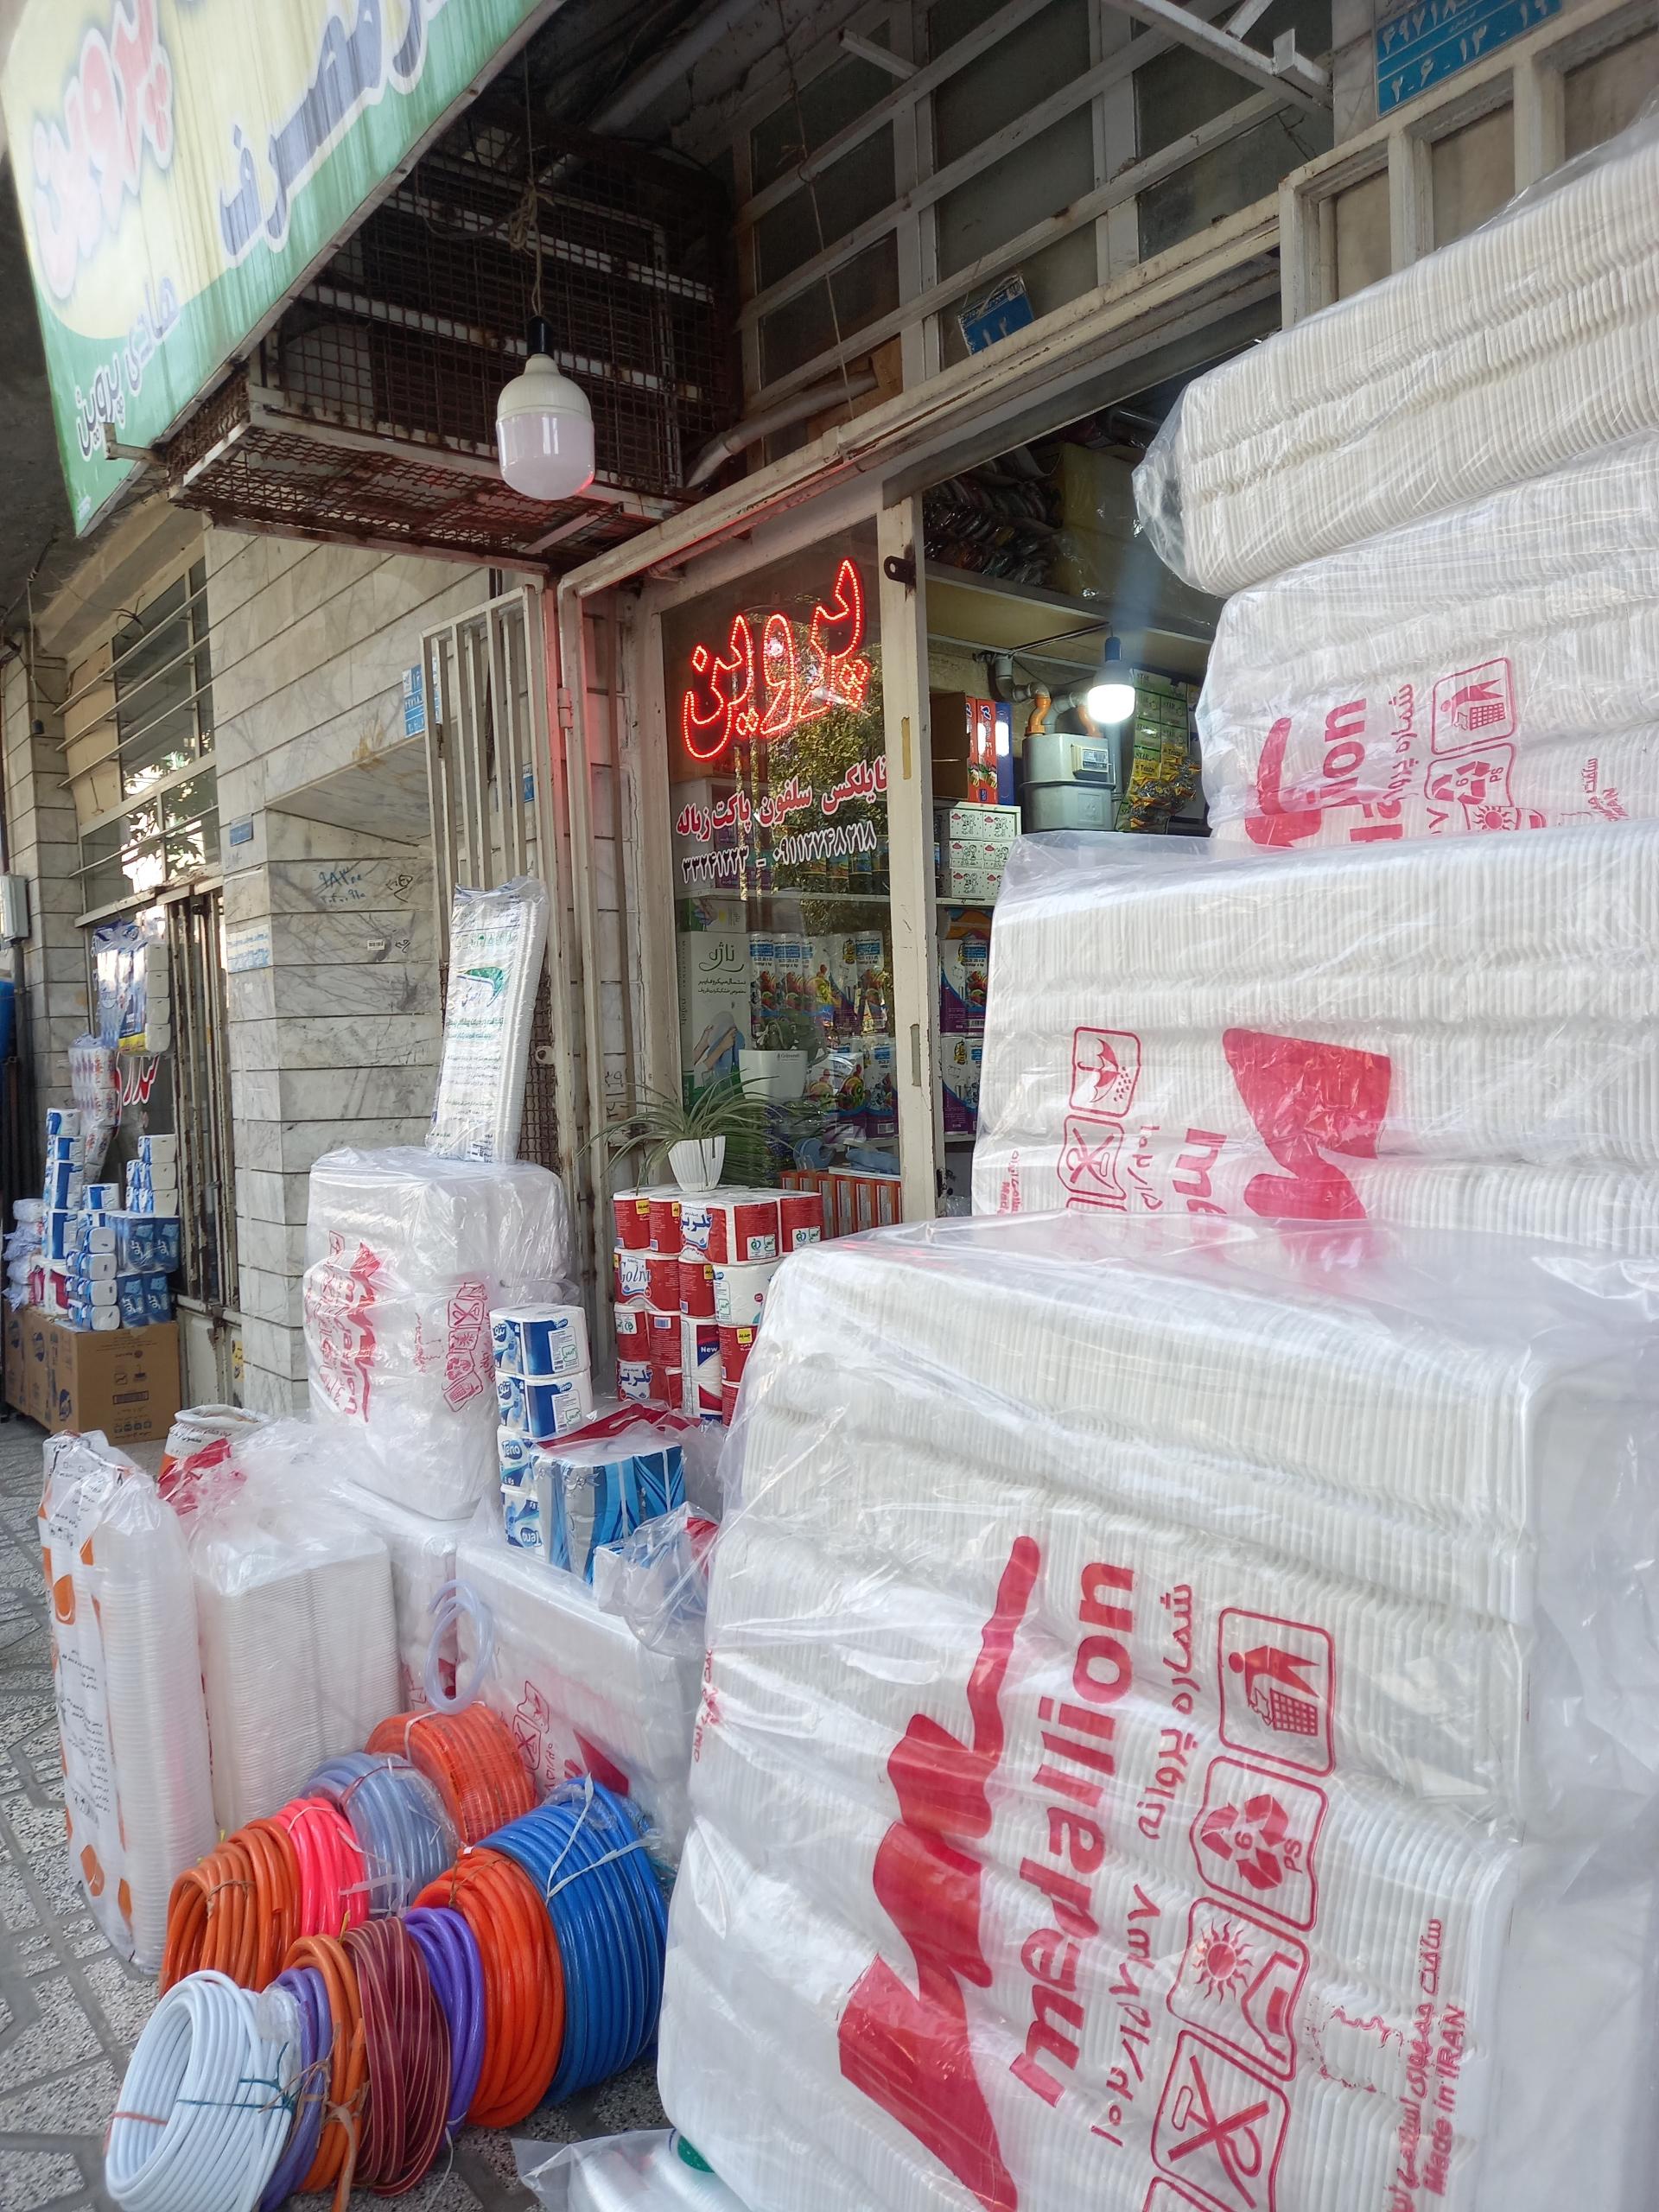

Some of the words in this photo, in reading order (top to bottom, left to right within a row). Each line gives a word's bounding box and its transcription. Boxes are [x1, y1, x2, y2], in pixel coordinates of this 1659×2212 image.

[682, 557, 871, 760] پروین
[677, 804, 713, 842] زباله
[712, 790, 752, 834] پاکت
[759, 776, 813, 827] سلفون
[501, 1440, 522, 1458] Teno
[521, 1529, 543, 1548] Teno
[1160, 1584, 1202, 1716] شماره
[1138, 1728, 1200, 1840] پروانه
[1008, 1562, 1136, 2108] medallion
[1284, 1840, 1304, 1874] PS
[1418, 1918, 1443, 1996] ساخت
[1406, 2002, 1434, 2100] جمهوری
[1436, 2003, 1466, 2080] IRAN
[1433, 2085, 1457, 2113] in
[1423, 2116, 1453, 2197] Made
